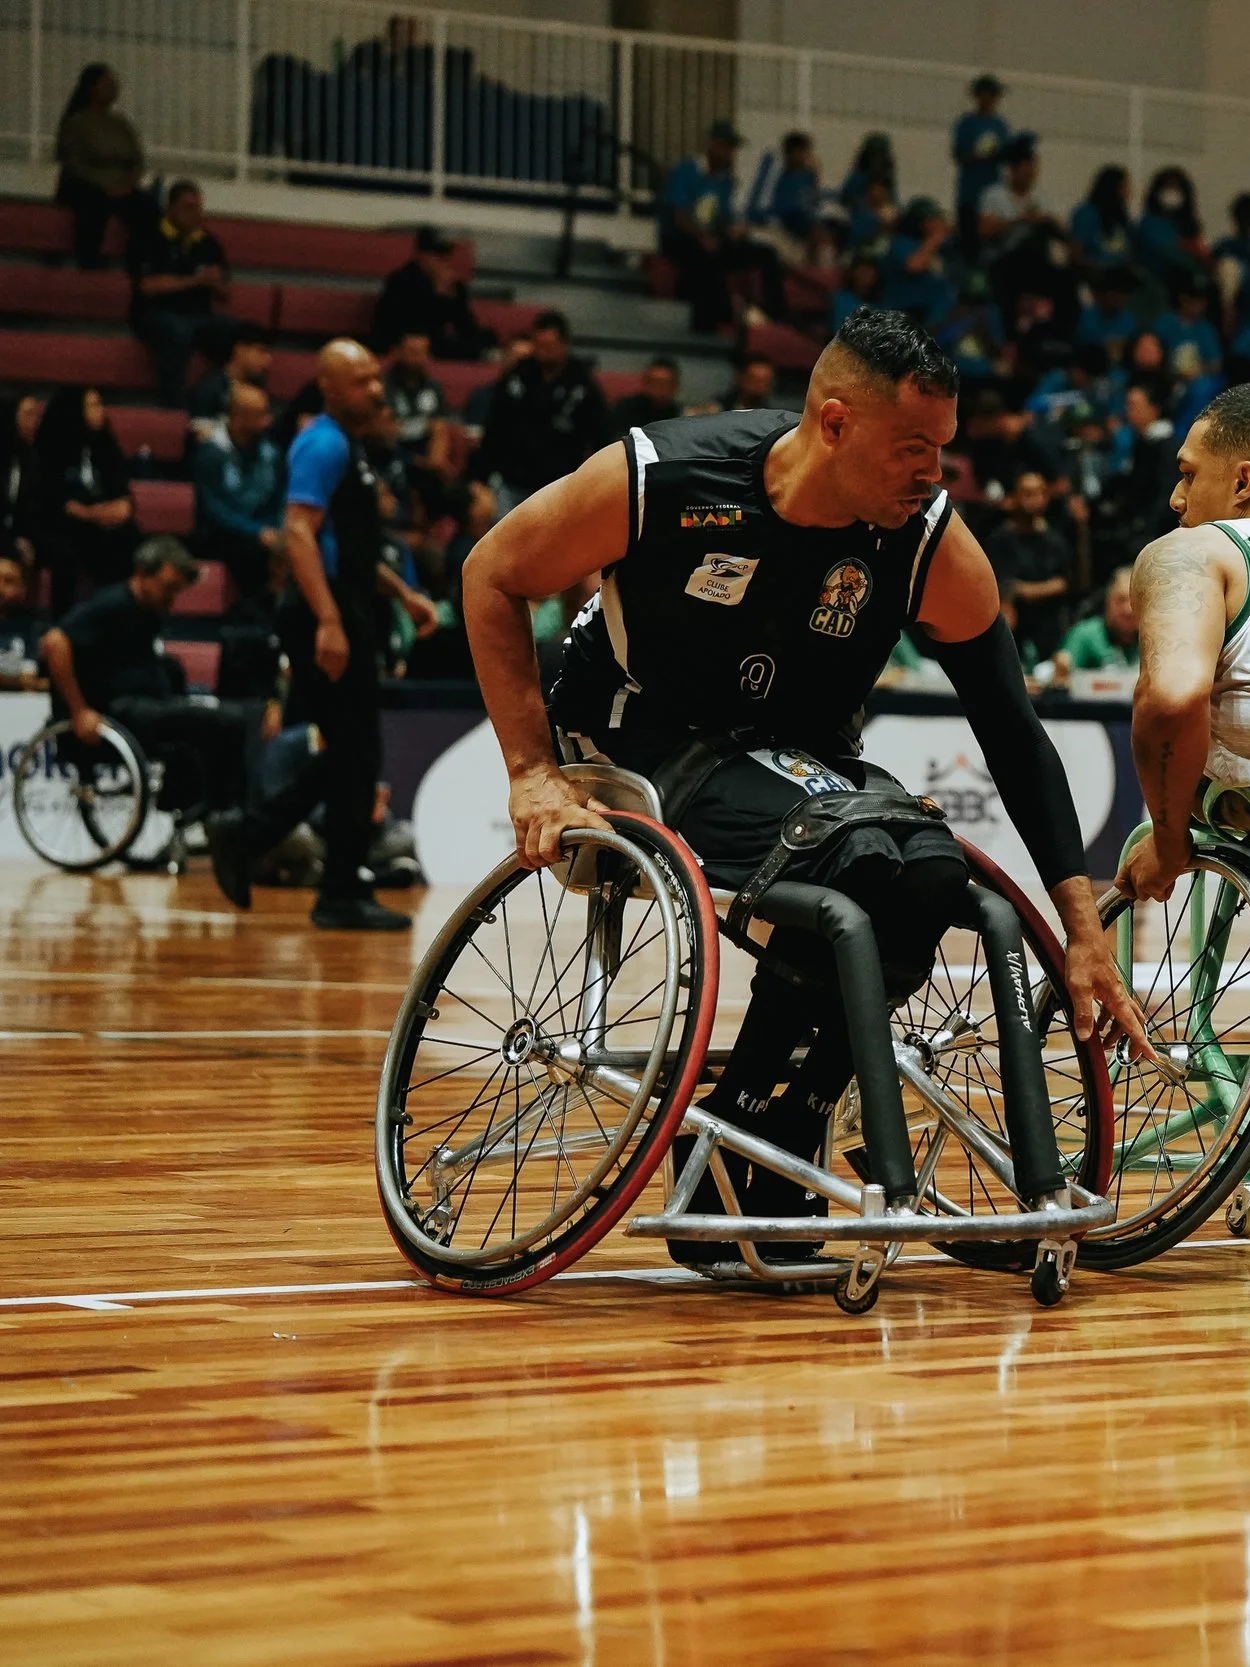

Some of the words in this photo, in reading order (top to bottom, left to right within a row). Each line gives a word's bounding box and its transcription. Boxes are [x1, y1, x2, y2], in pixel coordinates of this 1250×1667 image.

[697, 586, 731, 600] APOIADO
[706, 579, 730, 593] CLUBE
[810, 607, 855, 637] CAD
[740, 653, 776, 700] 9
[1005, 948, 1034, 1033] ALPHAMIX
